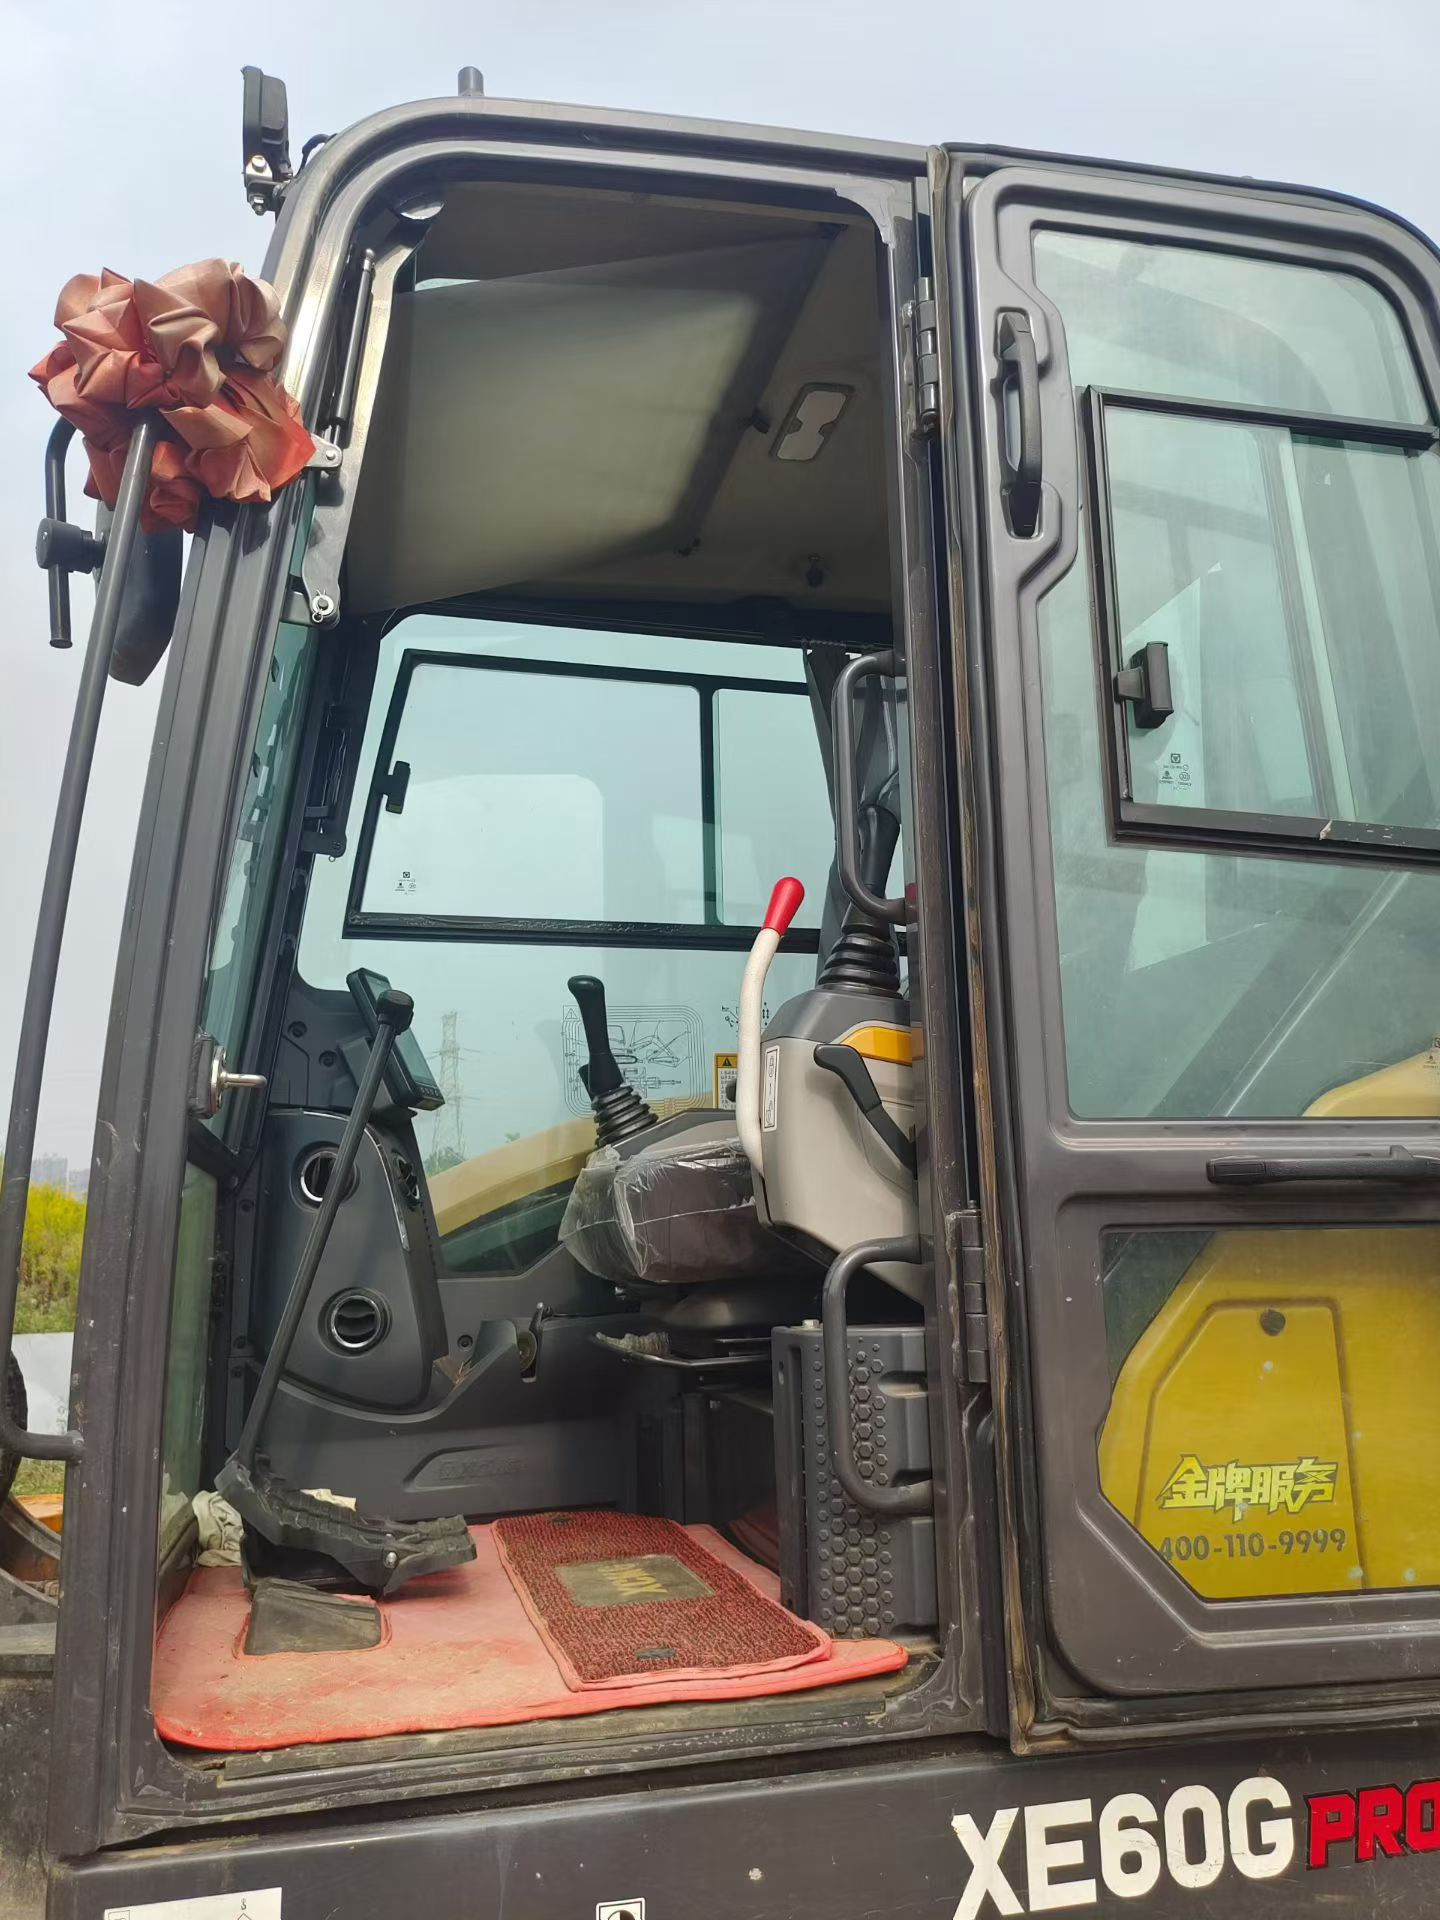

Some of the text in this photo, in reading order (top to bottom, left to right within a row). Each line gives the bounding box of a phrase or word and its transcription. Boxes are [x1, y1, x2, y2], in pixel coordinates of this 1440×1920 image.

[1157, 1454, 1338, 1523] 金牌服务
[1160, 1528, 1346, 1561] 400-110-9999
[951, 1776, 1440, 1920] XE60G PRO
